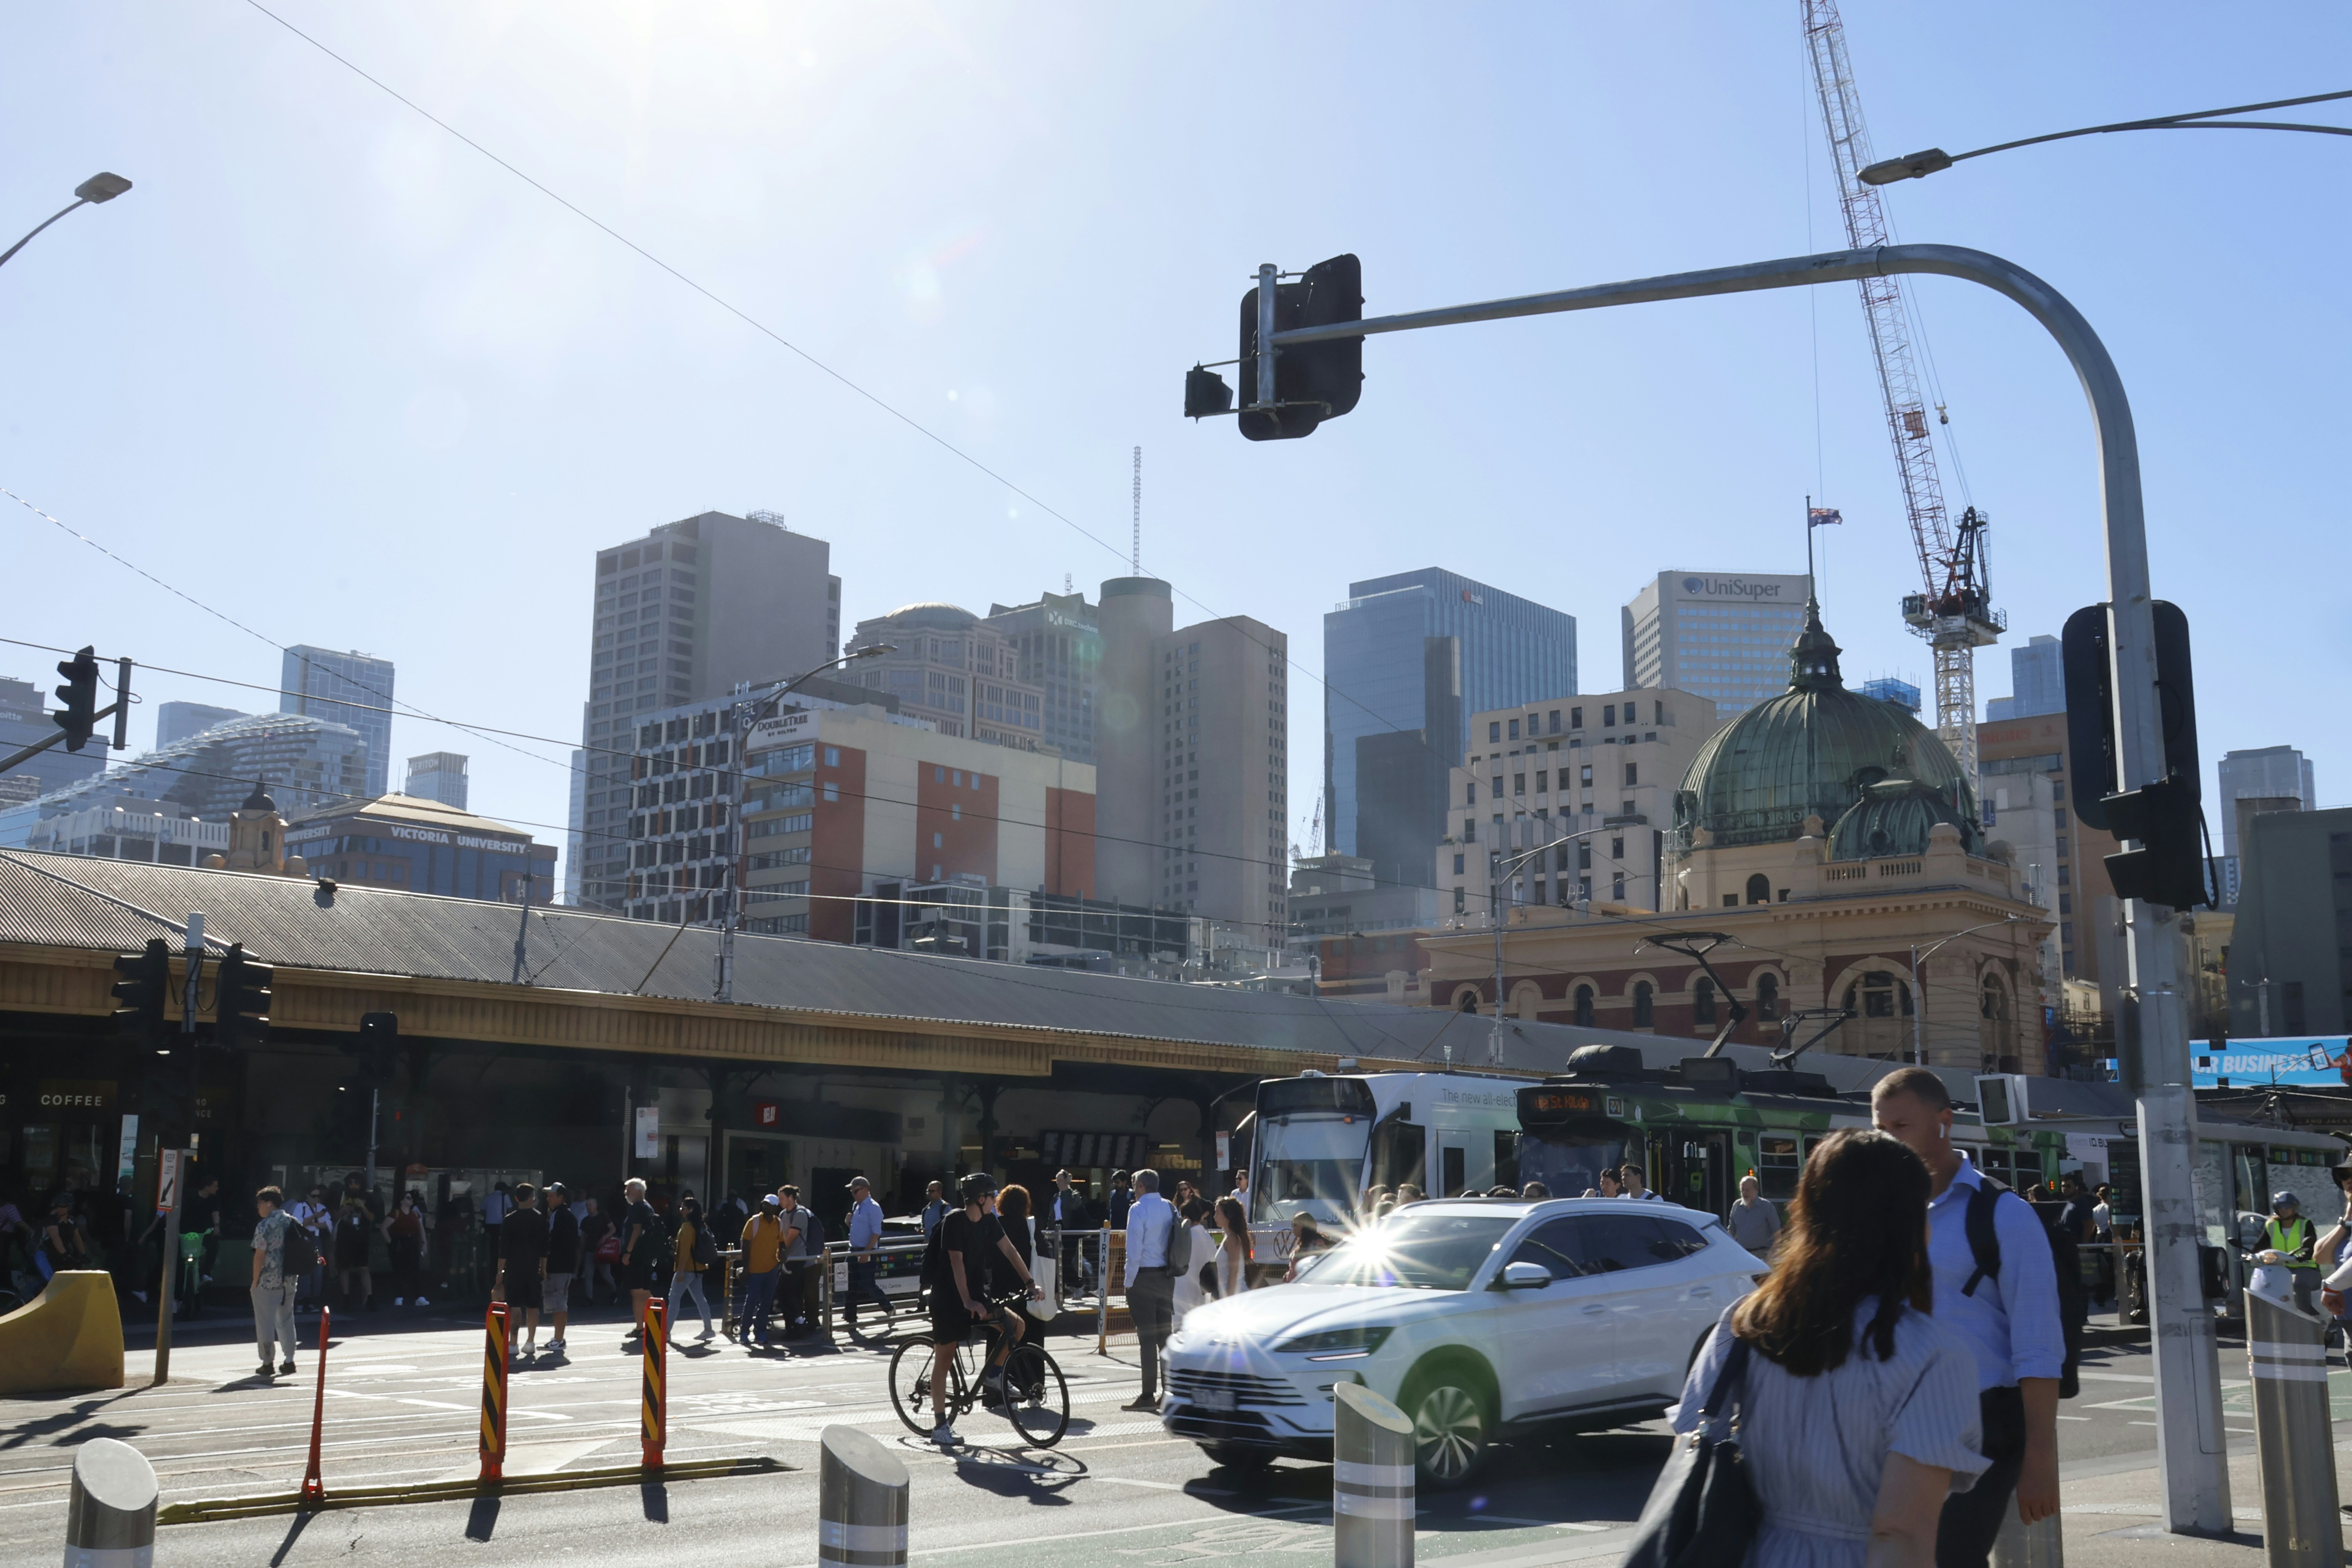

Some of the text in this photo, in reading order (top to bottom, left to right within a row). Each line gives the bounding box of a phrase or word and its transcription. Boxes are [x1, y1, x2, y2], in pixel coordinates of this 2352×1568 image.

[1705, 579, 1781, 601] UniSuper
[1471, 594, 1483, 605] nab
[391, 826, 526, 854] VICTORIA UNIVERSITY
[2222, 1054, 2310, 1073] BUSINESS
[41, 1095, 102, 1106] COFFEE
[1442, 1089, 1459, 1102] The
[1462, 1093, 1481, 1104] new
[763, 1106, 776, 1123] RELAY
